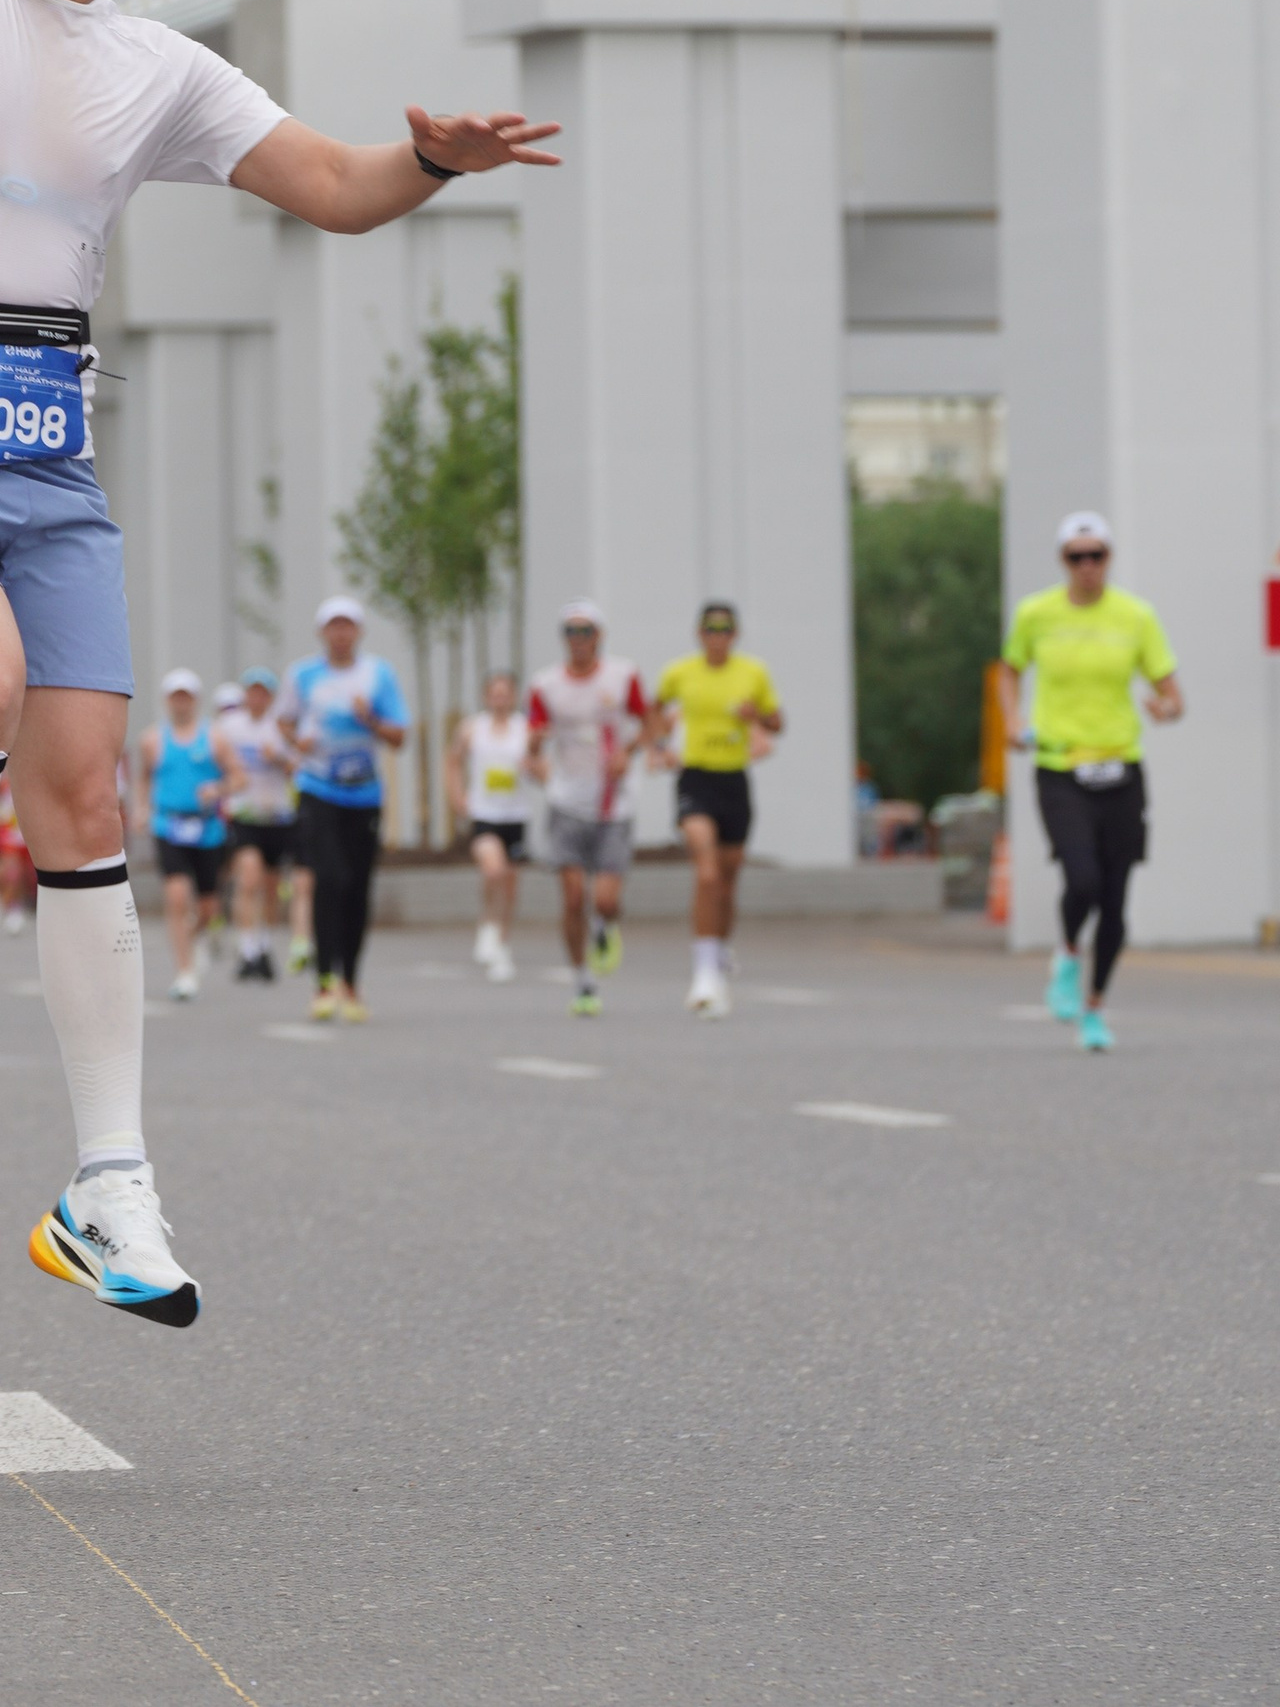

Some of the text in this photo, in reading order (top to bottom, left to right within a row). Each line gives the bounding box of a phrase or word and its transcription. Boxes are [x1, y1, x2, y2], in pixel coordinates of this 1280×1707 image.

[15, 346, 43, 360] Halyk
[15, 367, 41, 376] HALF
[14, 374, 63, 388] MARATHON
